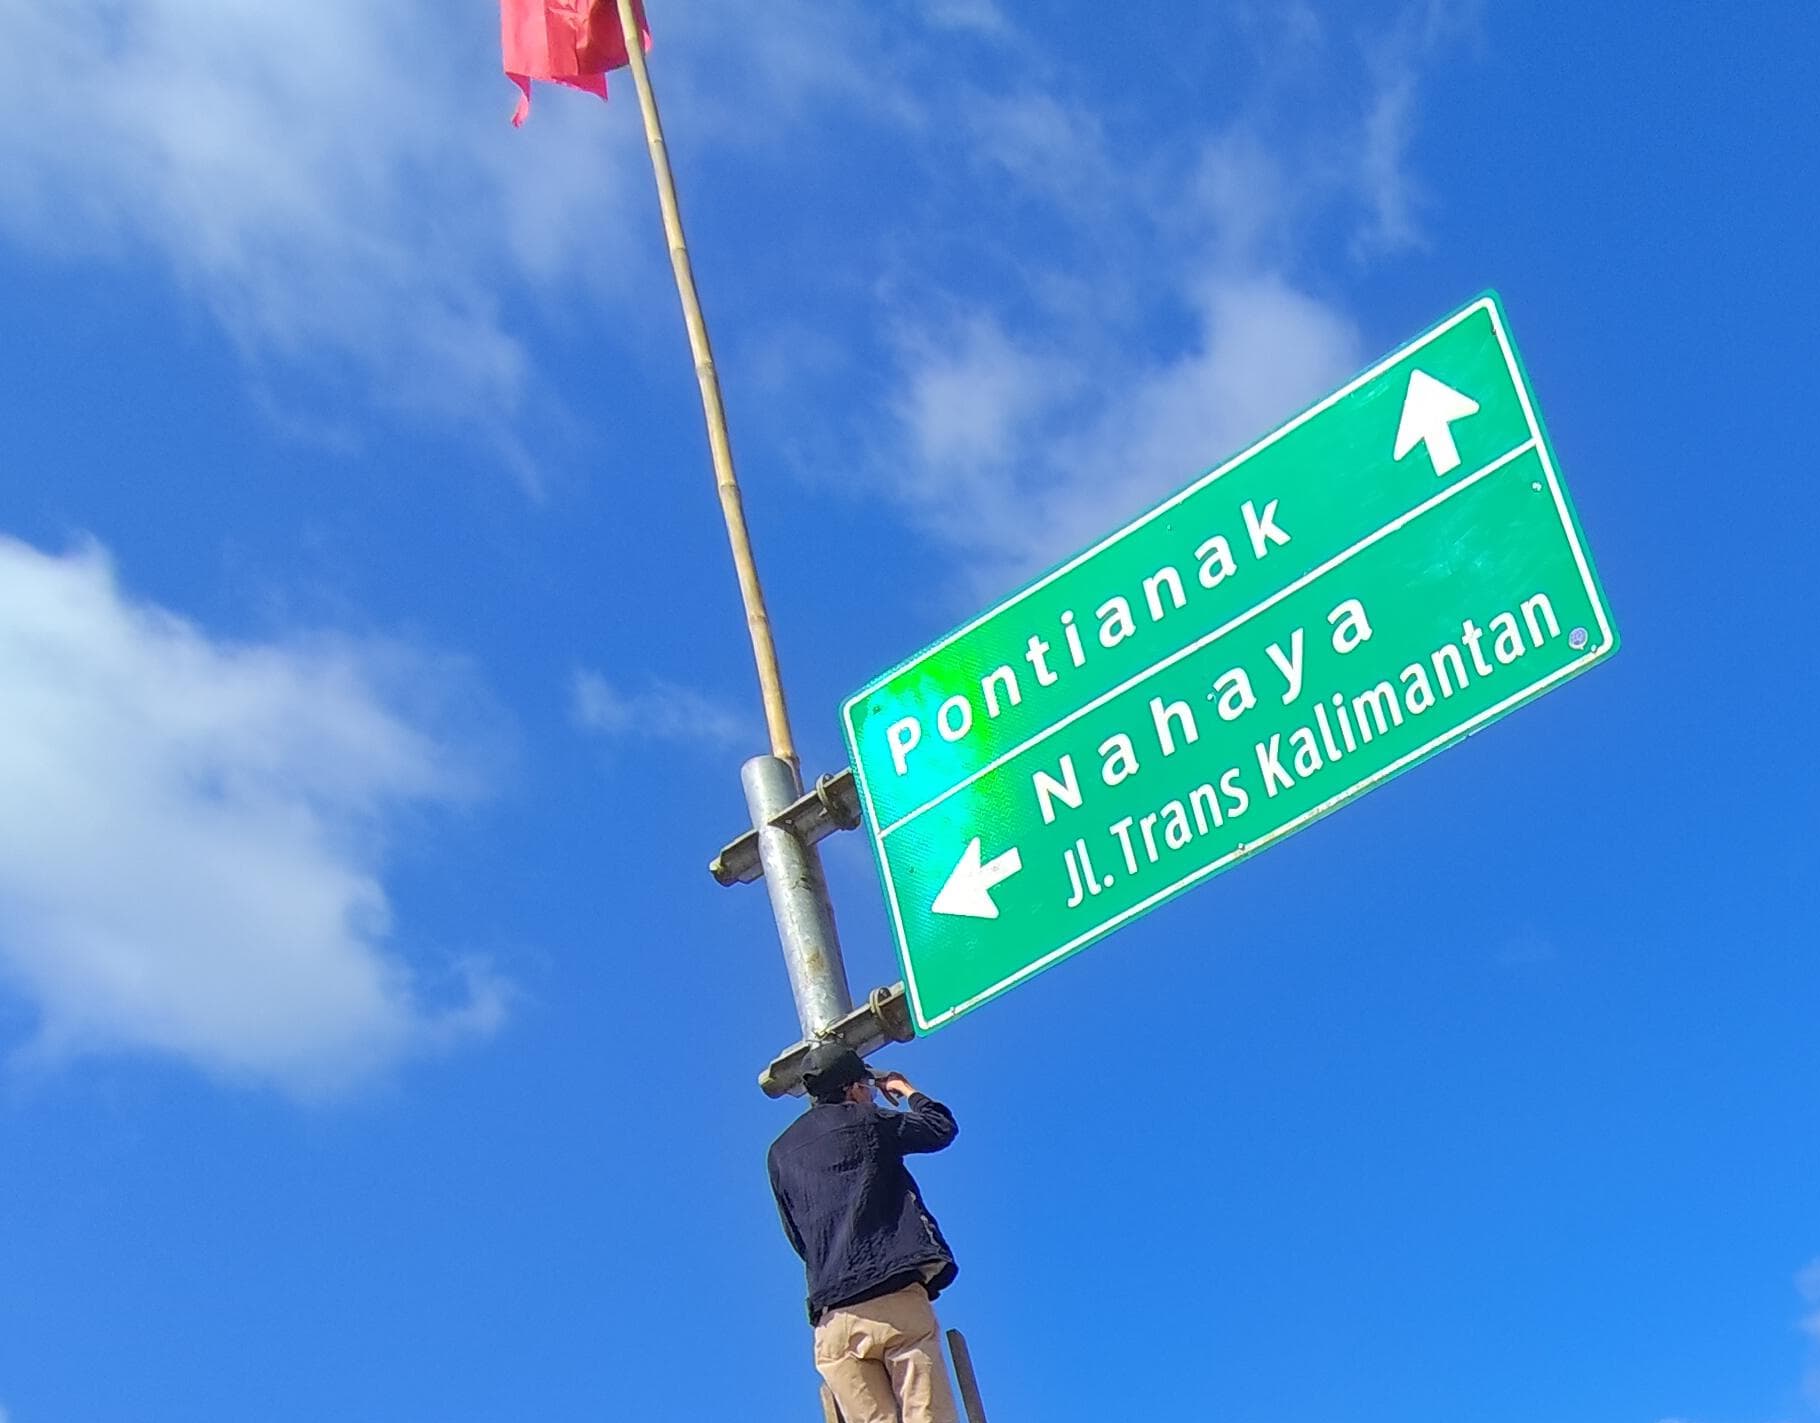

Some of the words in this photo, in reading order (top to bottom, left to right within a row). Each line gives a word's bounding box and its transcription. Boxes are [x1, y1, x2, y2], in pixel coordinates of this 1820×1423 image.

[886, 499, 1292, 776] Pontianak
[1032, 598, 1373, 825] Nahaya
[1063, 838, 1115, 909] Jl.
[1109, 768, 1250, 875] Trans
[1254, 592, 1561, 798] Kalimantan
